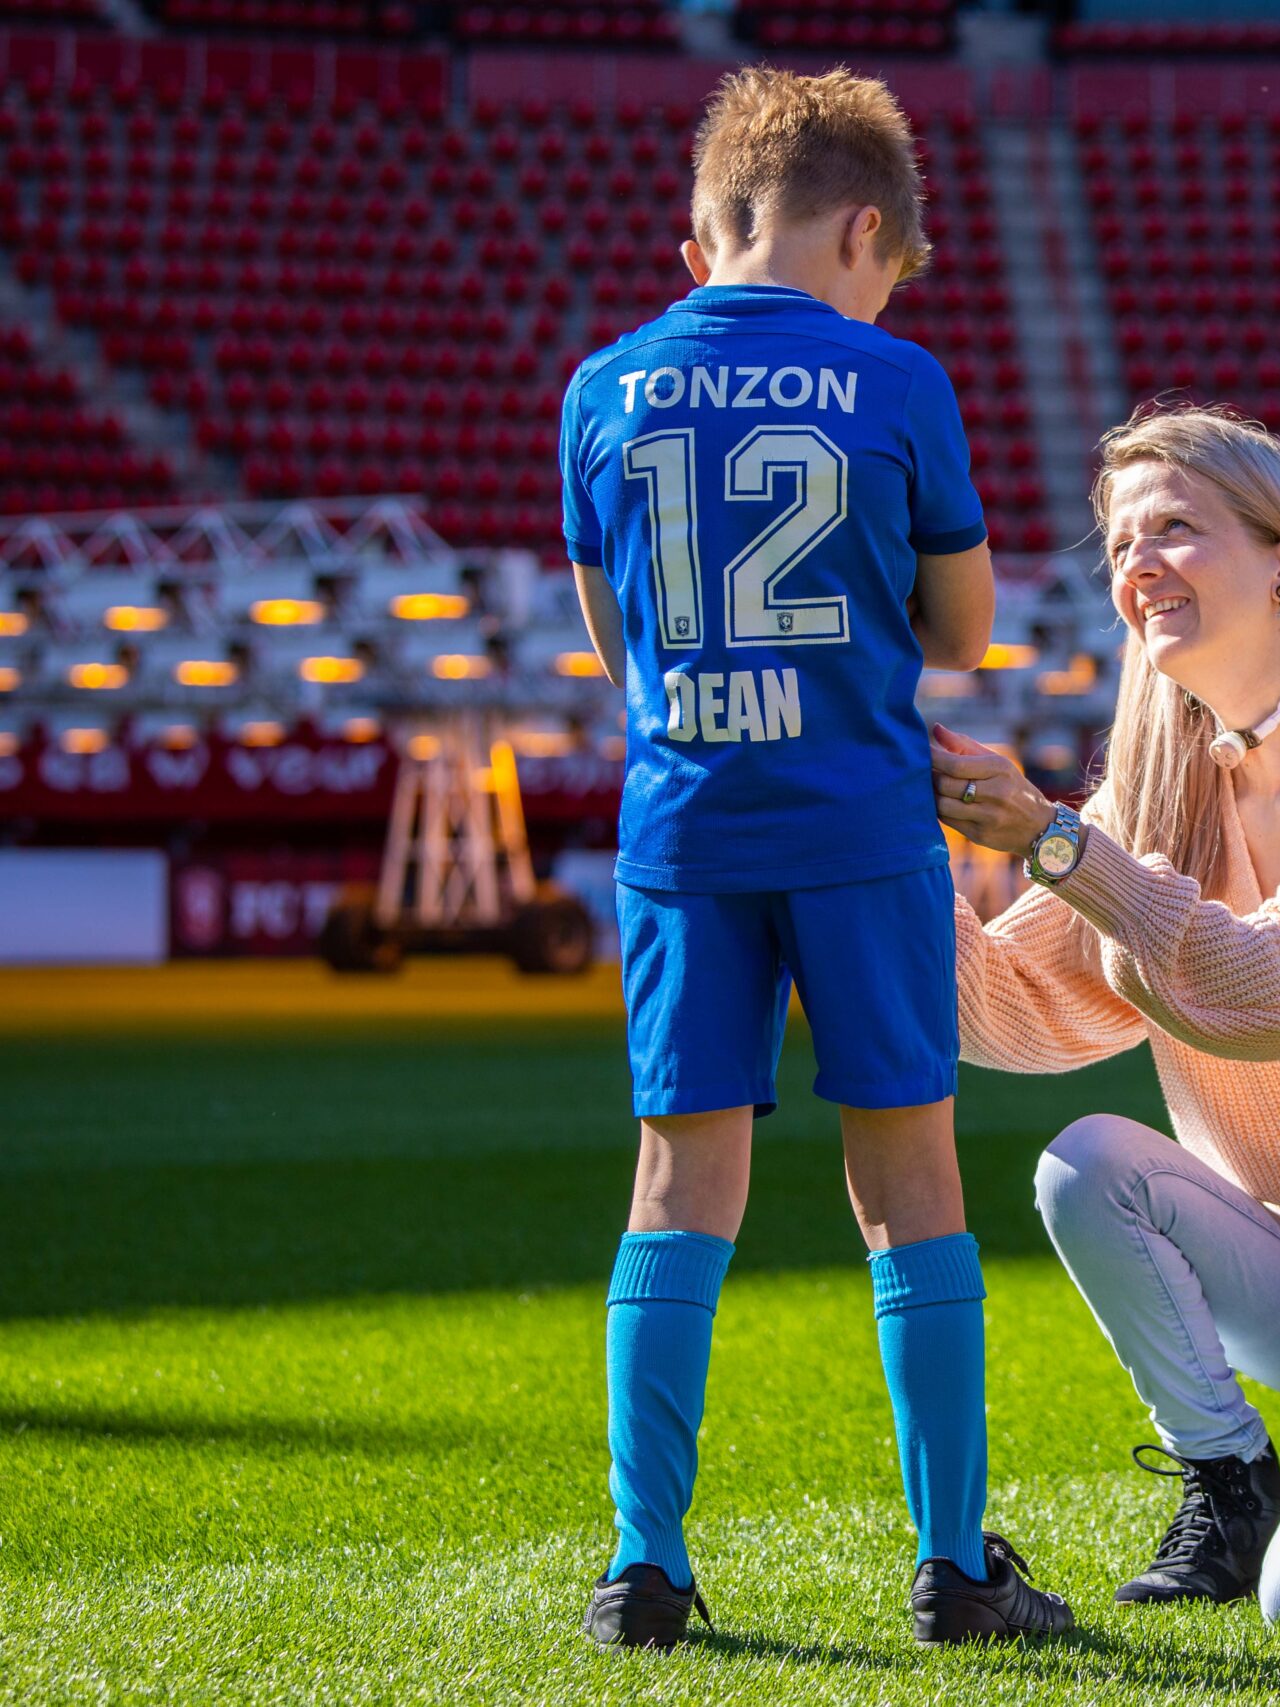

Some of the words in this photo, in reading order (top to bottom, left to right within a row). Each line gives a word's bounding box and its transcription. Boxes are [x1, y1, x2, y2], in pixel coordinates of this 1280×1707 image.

[619, 366, 858, 413] TONZON
[622, 425, 851, 650] 12
[664, 667, 802, 743] DEAN
